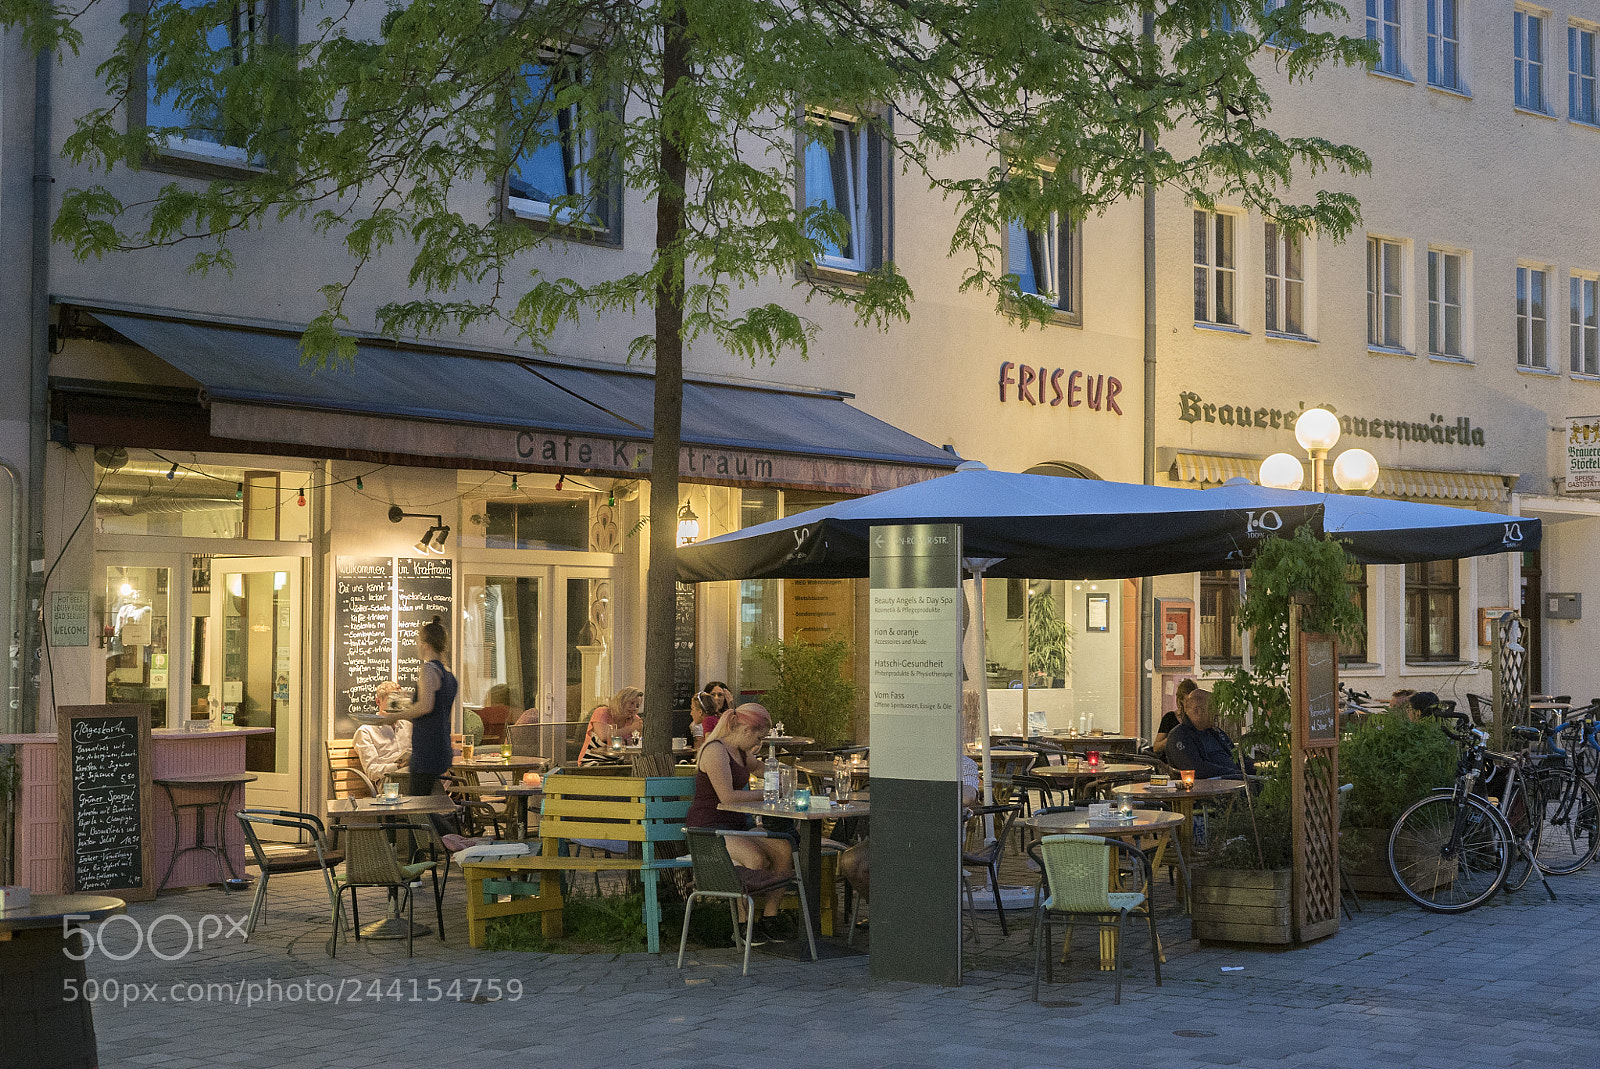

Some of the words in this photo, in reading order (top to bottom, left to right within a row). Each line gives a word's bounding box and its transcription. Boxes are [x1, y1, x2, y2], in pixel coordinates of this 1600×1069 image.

[999, 361, 1123, 415] FRISEUR
[1179, 391, 1305, 431] Brauere
[1317, 403, 1485, 447] auernwärtla
[516, 431, 593, 463] Cafe
[613, 440, 773, 478] Krtraum
[413, 561, 451, 575] Kraftraum
[352, 585, 364, 593] uns
[875, 597, 895, 606] Beauty
[896, 597, 917, 606] Angels
[926, 597, 939, 606] Day
[940, 597, 953, 605] Spa
[54, 626, 86, 635] WELCOME
[889, 628, 895, 636] &
[896, 628, 919, 638] oranje
[874, 659, 944, 668] Hatschi-Gesundheit
[874, 691, 889, 699] Vom
[890, 691, 905, 699] Fass
[76, 721, 126, 739] Tageskarte
